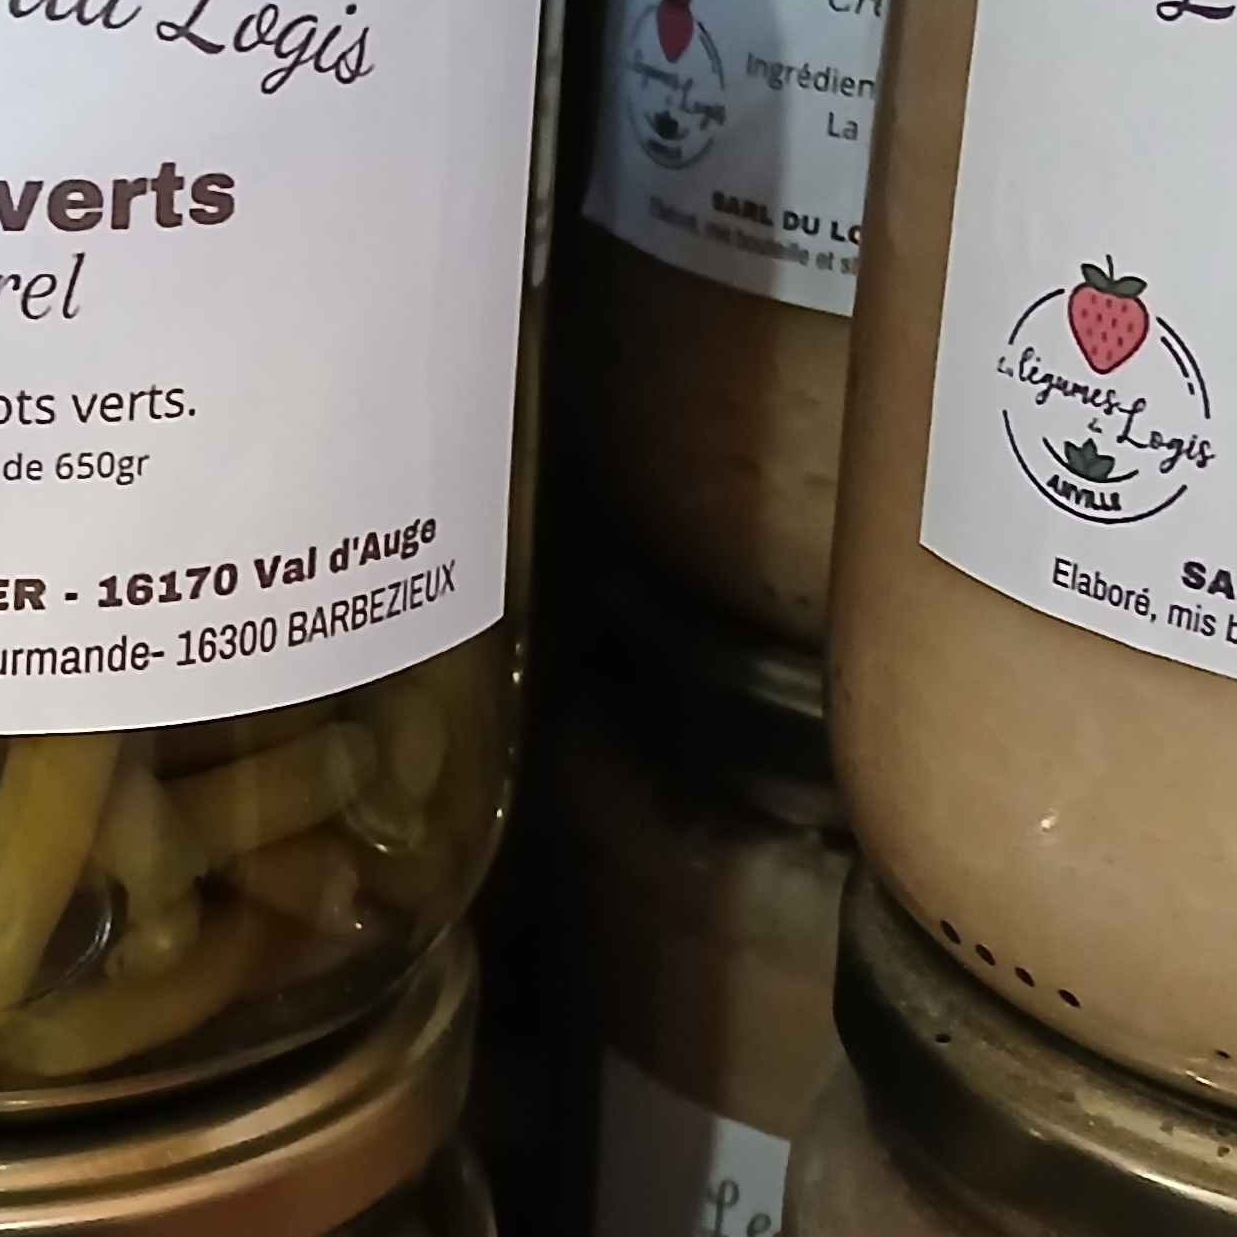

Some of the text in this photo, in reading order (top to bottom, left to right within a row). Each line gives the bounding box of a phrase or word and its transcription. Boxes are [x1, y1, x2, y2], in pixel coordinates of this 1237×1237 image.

[782, 210, 821, 236] DU
[70, 384, 197, 424] verts.
[1116, 397, 1216, 474] Logis
[2, 451, 44, 482] de
[54, 450, 151, 486] 650gr
[64, 591, 79, 602] -
[97, 562, 239, 608] 16170
[252, 545, 318, 590] Val
[328, 516, 438, 575] d'Auge
[1052, 556, 1157, 623] Elaboré,
[1167, 604, 1217, 637] mis
[175, 616, 279, 667] 16300
[287, 558, 456, 648] BARBEZIEUX
